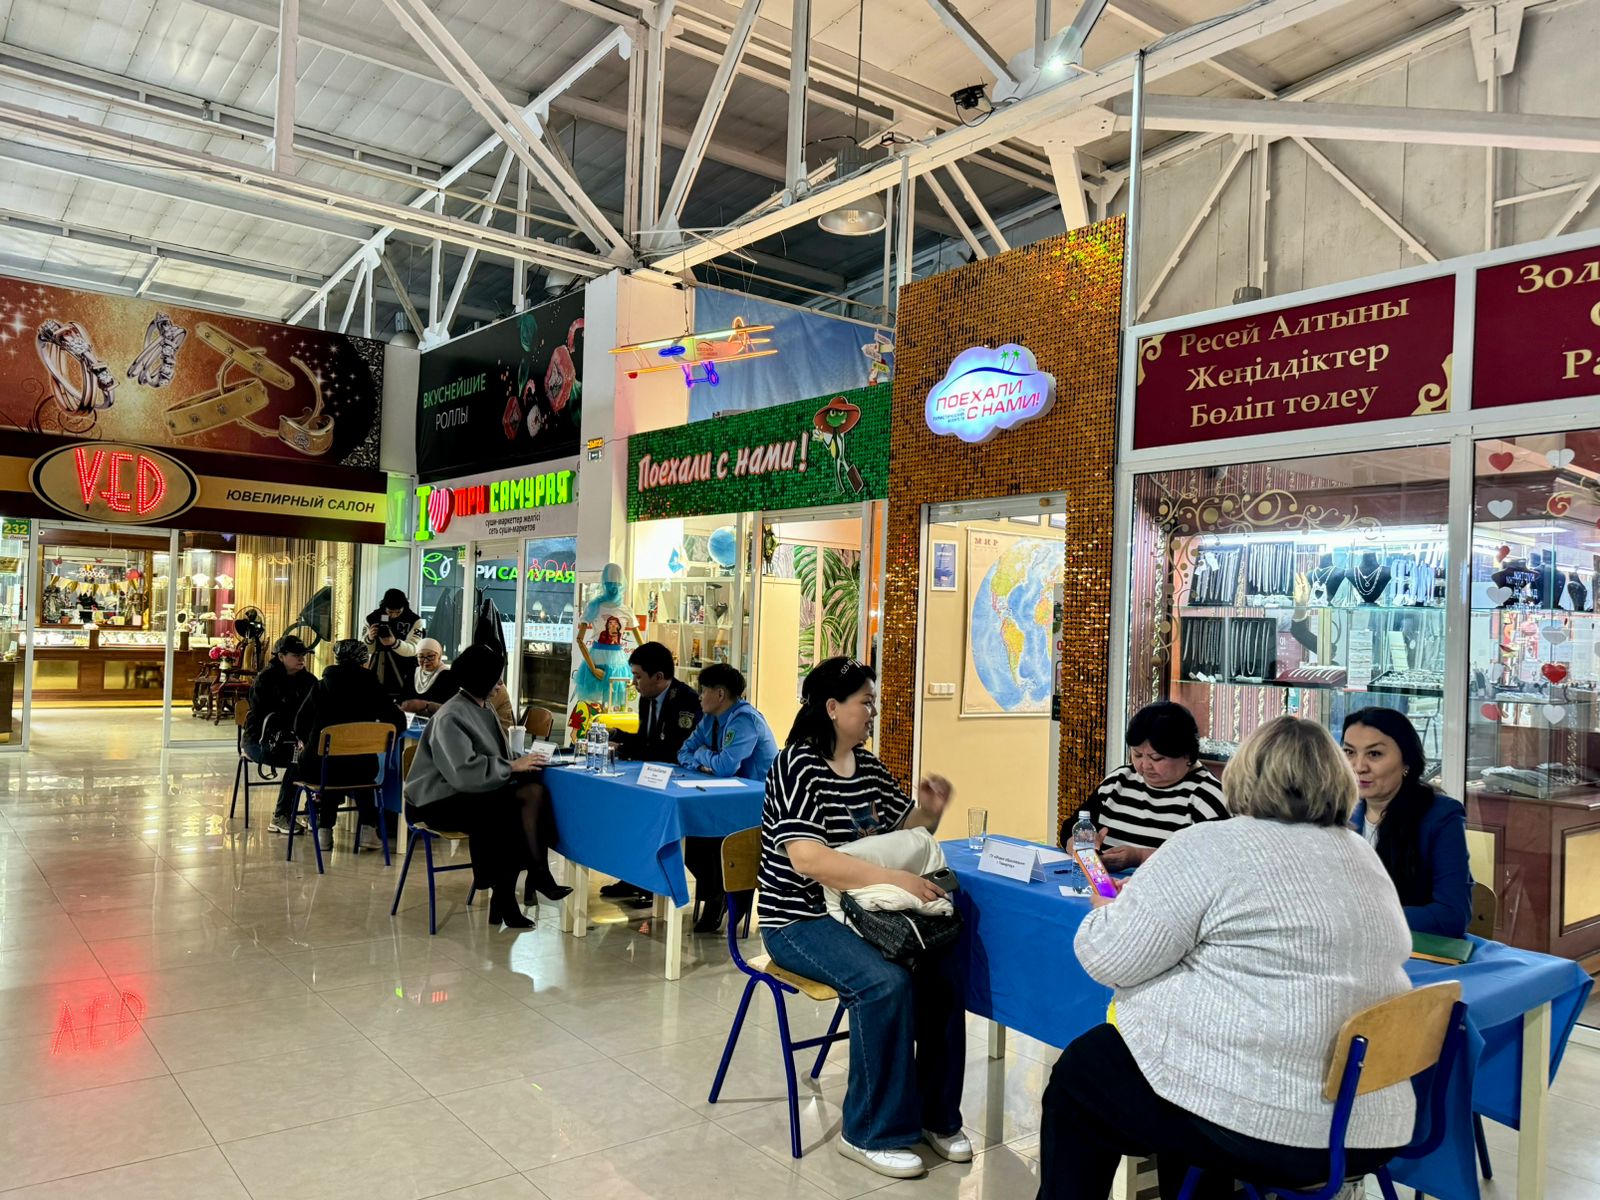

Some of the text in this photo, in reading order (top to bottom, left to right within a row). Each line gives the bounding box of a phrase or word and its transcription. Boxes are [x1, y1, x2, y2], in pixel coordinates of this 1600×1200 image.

[1179, 297, 1411, 357] Ресей Алтыны
[1185, 342, 1390, 392] Жеңілдіктер
[423, 372, 487, 409] ВКУСНЕЙШИЕ
[935, 379, 1023, 412] ПОЕХАЛИ
[966, 406, 979, 420] С
[981, 391, 1041, 417] НАМИ!
[1190, 385, 1379, 428] Бөліп төлеу
[435, 405, 469, 431] РОЛЛЫ
[74, 447, 167, 516] VED
[637, 451, 712, 492] Поехали
[716, 450, 729, 481] с
[226, 489, 375, 513] ЮВЕЛИРНЫЙ САЛОН
[454, 484, 490, 517] ТРИ
[490, 469, 576, 514] САМУРАЯ
[3, 523, 28, 535] 232
